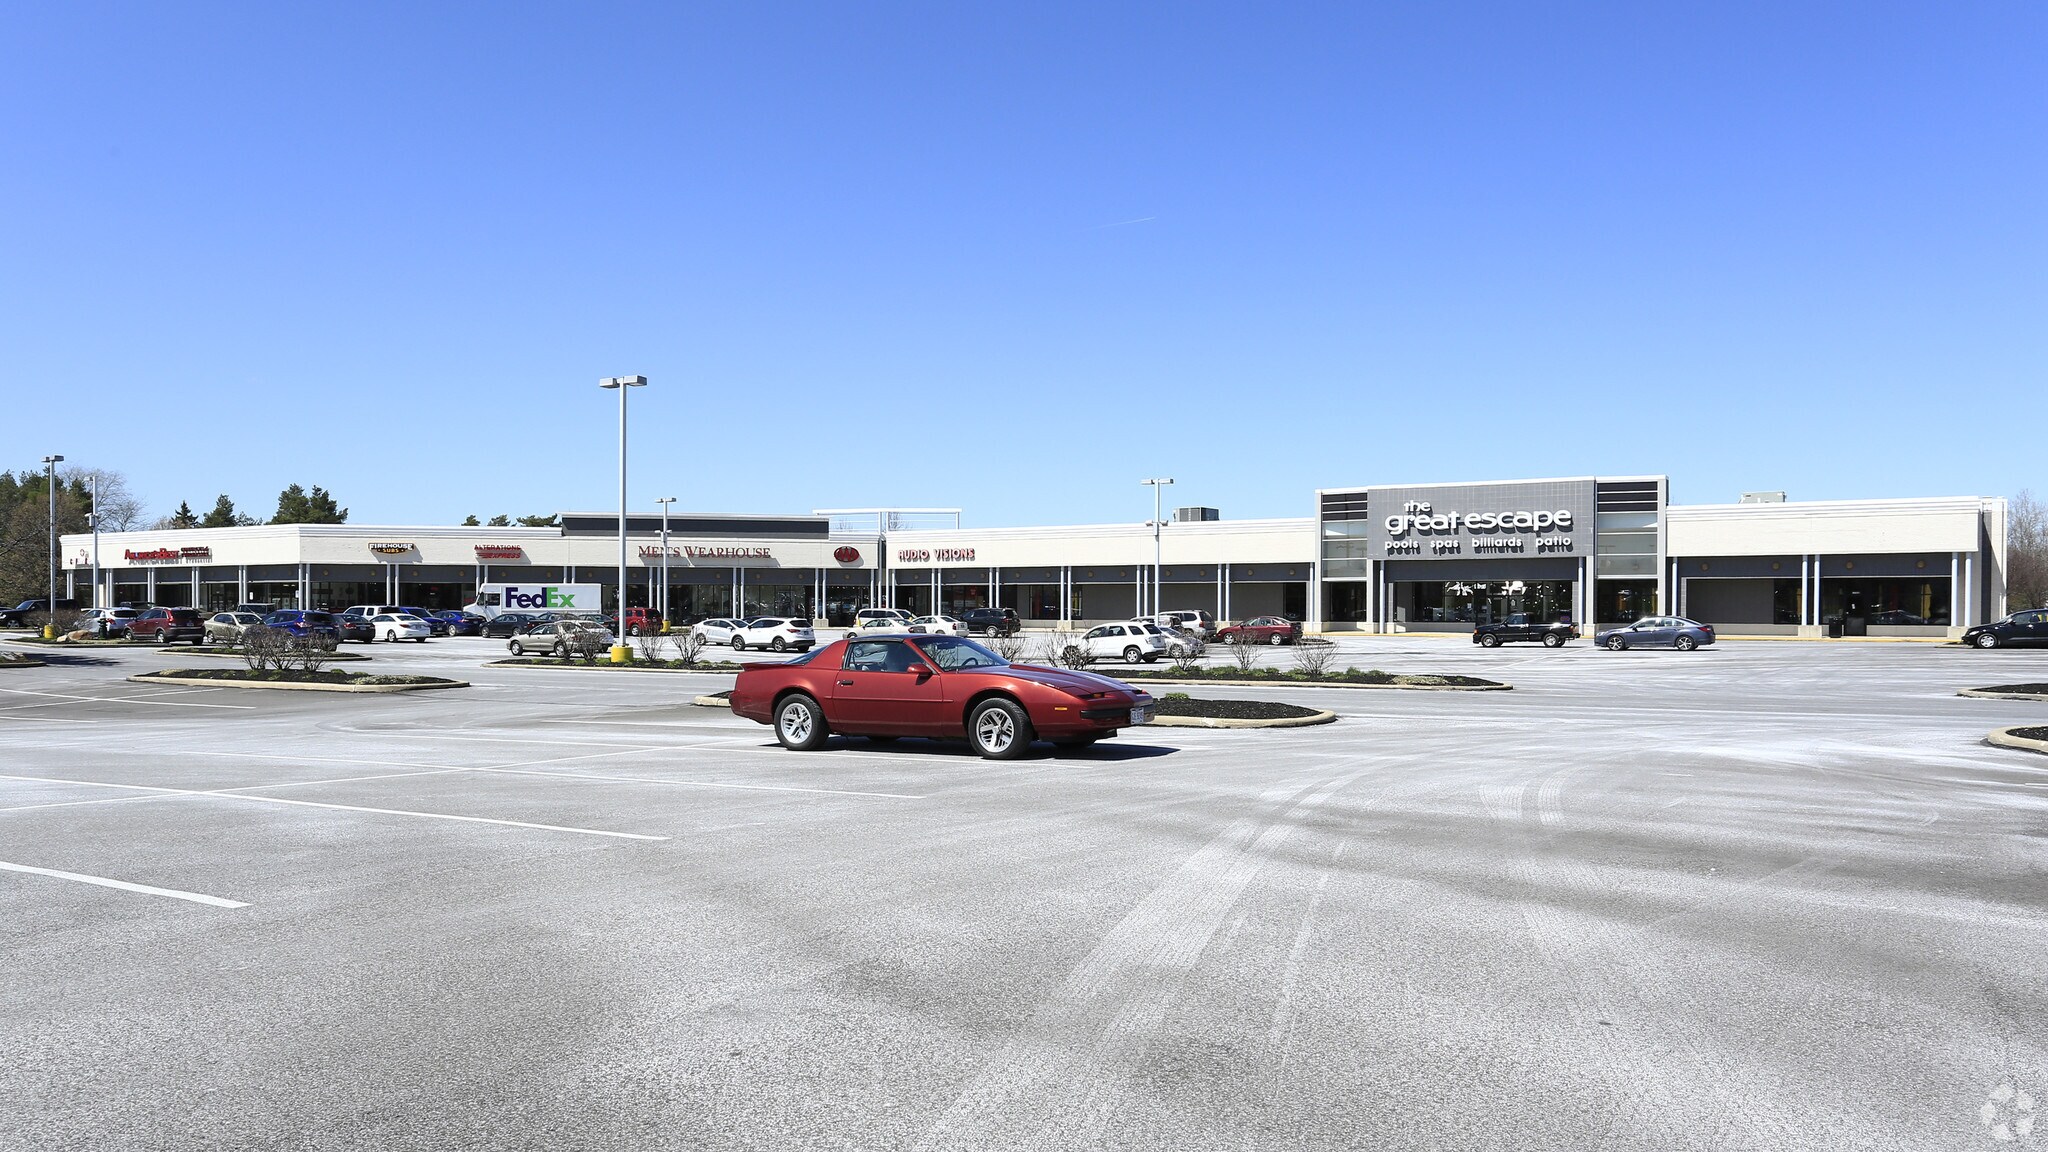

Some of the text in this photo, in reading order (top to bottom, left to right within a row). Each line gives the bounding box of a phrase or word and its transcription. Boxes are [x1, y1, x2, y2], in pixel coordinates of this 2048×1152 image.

[1404, 500, 1431, 512] the
[1384, 508, 1572, 535] great escape
[1385, 536, 1571, 551] pools spas billiards patio
[684, 545, 771, 559] WEARHOUSE
[898, 547, 974, 560] AUDIO VISIONS
[505, 586, 575, 609] FedEx
